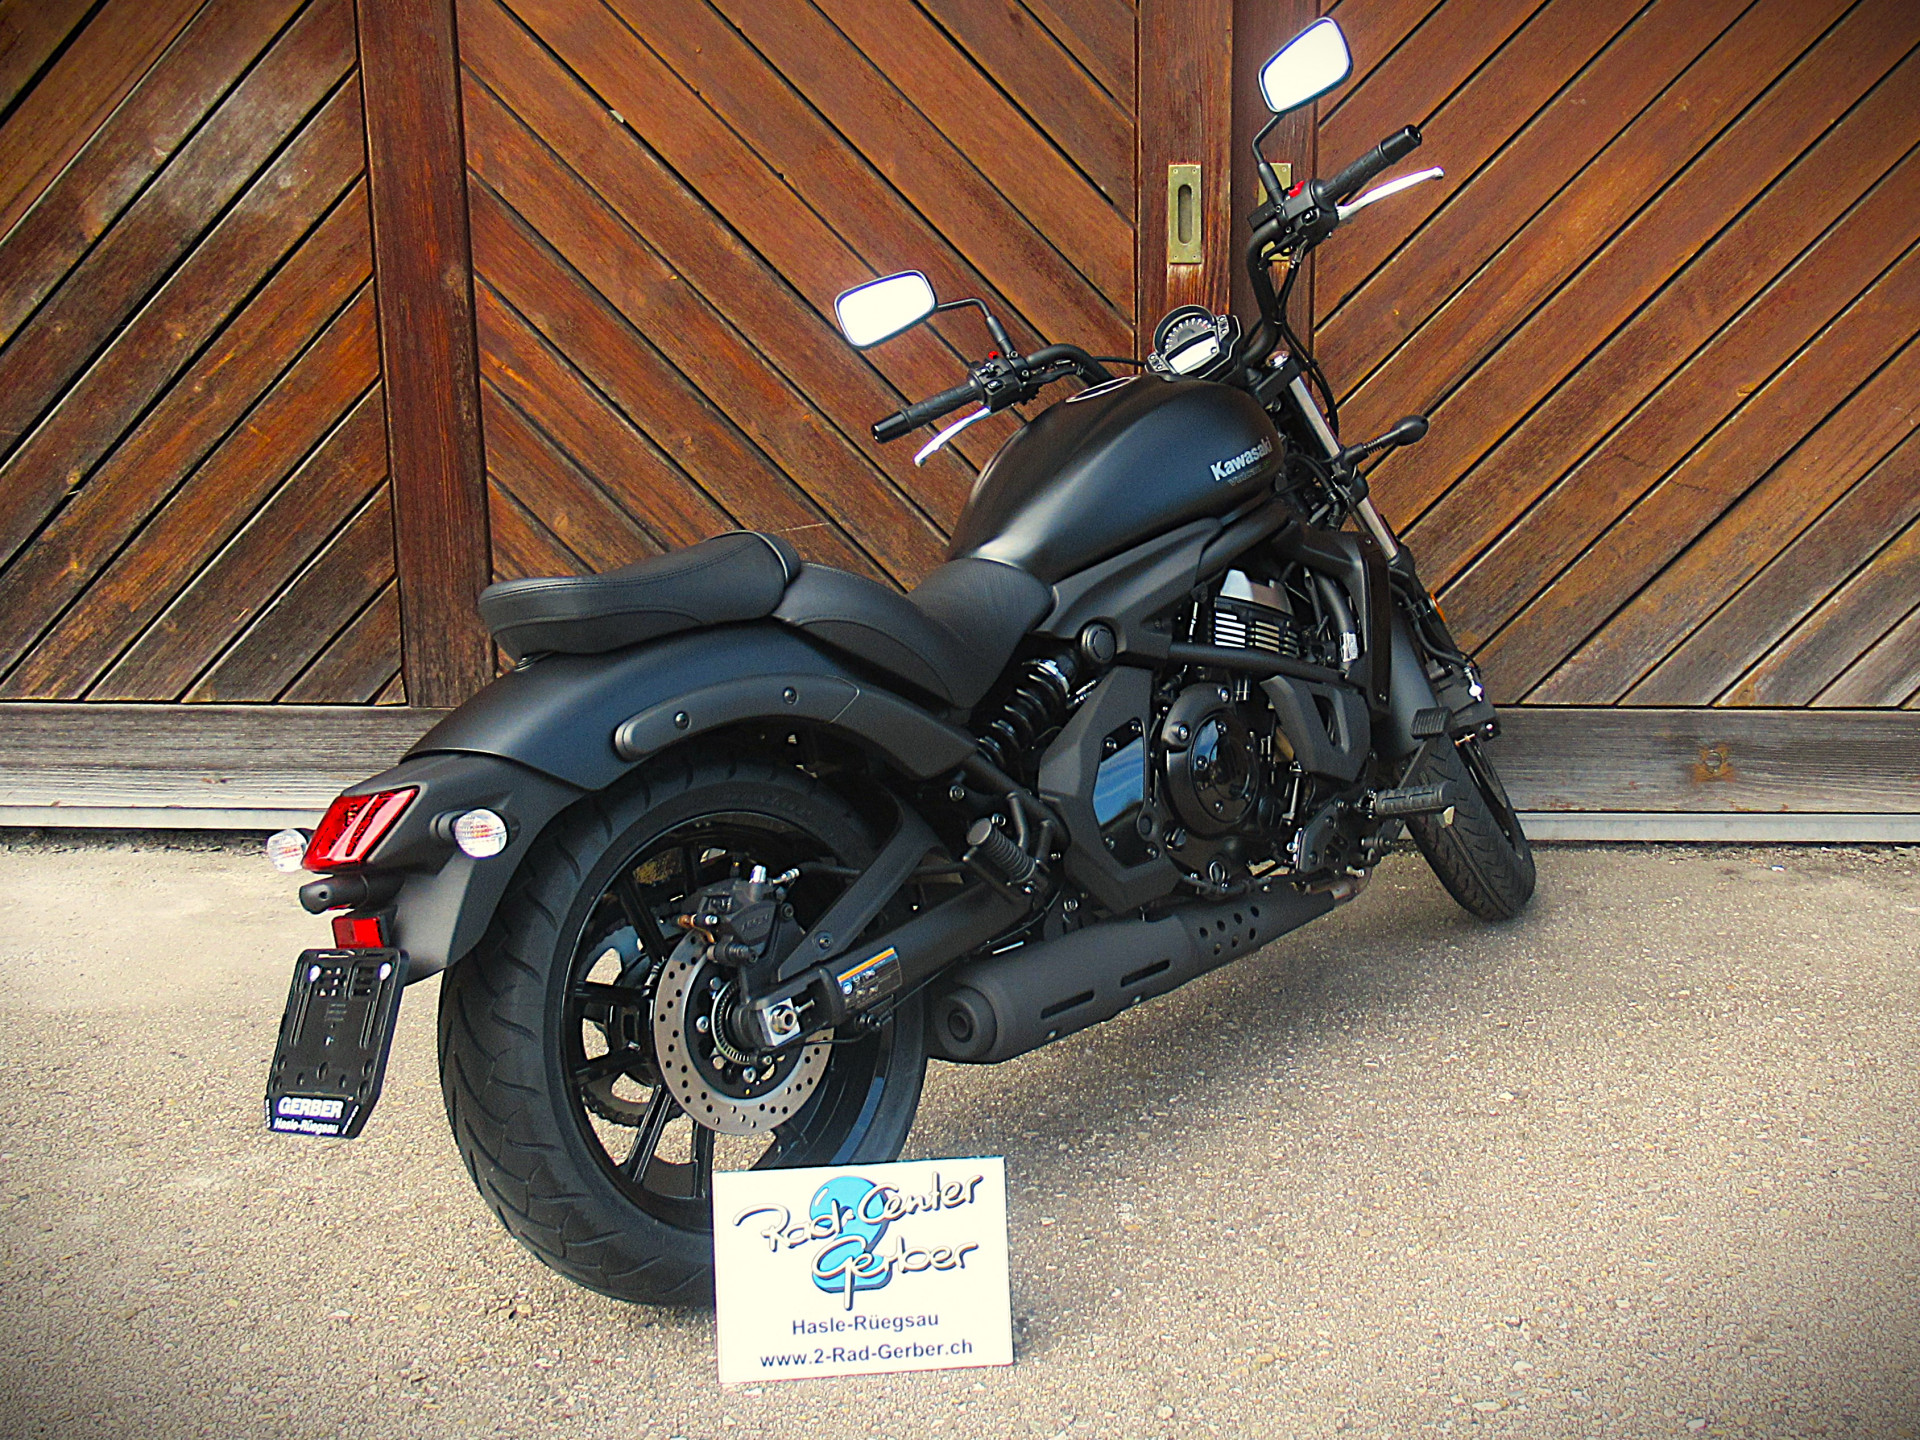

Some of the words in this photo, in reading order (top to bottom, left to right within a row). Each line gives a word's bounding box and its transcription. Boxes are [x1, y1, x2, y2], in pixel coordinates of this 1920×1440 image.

[1210, 435, 1272, 481] Kawasaki
[277, 1096, 344, 1119] GERBER
[811, 1234, 979, 1311] Gerber
[792, 1313, 939, 1335] Hasle-Rüegsau
[760, 1339, 973, 1367] www.2-Rad-Gerber.ch
